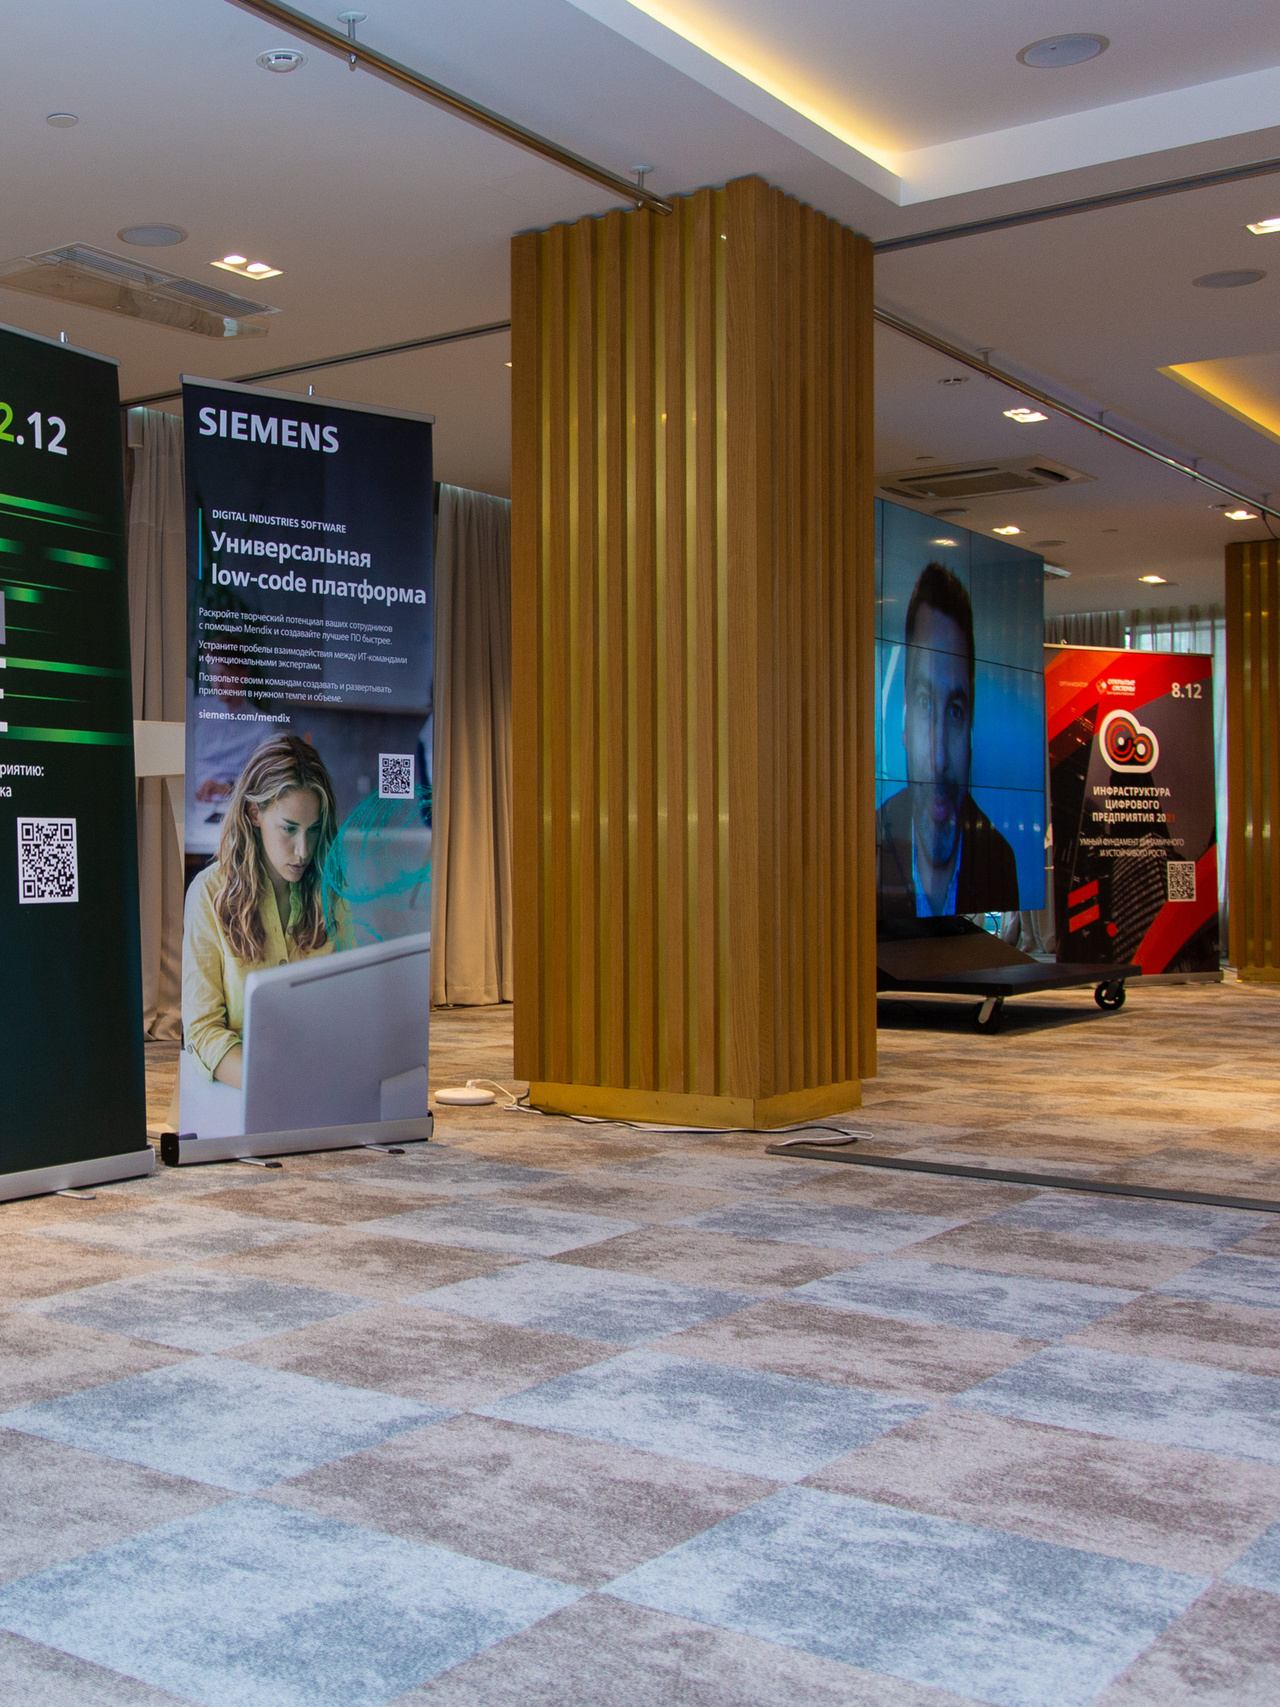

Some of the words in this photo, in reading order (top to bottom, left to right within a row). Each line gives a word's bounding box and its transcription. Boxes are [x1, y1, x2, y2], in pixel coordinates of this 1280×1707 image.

[198, 406, 340, 454] SIEMENS
[212, 509, 247, 522] DIGITAL
[249, 514, 299, 528] INDUSTRIES
[300, 520, 347, 534] SOFTWARE
[211, 530, 371, 569] Универсальная
[211, 563, 307, 593] low-code
[312, 579, 426, 606] платформа
[198, 607, 239, 620] Раскройте
[241, 612, 284, 624] творческий
[286, 616, 324, 628] потенциал
[325, 619, 348, 629] ваших
[349, 622, 393, 634] сотрудников
[204, 624, 242, 634] помощью
[244, 625, 272, 635] Mendix
[280, 629, 321, 640] создавайте
[322, 633, 349, 642] лучшее
[351, 634, 361, 642] ПО
[362, 634, 393, 646] быстрее.
[198, 640, 238, 652] Устраните
[239, 645, 272, 655] пробелы
[274, 647, 333, 659] взаимодействия
[334, 651, 357, 662] между
[358, 652, 408, 664] ИТ-командами
[205, 655, 277, 667] функциональными
[278, 660, 322, 671] экспертами.
[198, 672, 239, 683] Позвольте
[240, 677, 264, 685] своим
[265, 678, 302, 688] командам
[303, 681, 339, 690] создавать
[346, 683, 392, 693] развертывать
[1171, 682, 1202, 699] 8.12
[198, 687, 246, 697] приложения
[253, 691, 284, 701] нужном
[285, 692, 306, 701] темпе
[313, 693, 343, 703] объеме.
[198, 710, 291, 724] siemens.com/mendix
[1092, 786, 1171, 797] ИНФРАСТРУКТУРА
[1105, 799, 1160, 811] ЦИФРОВОГО
[1092, 812, 1155, 824] ПРЕДПРИЯТИЯ
[1156, 813, 1176, 823] 2021
